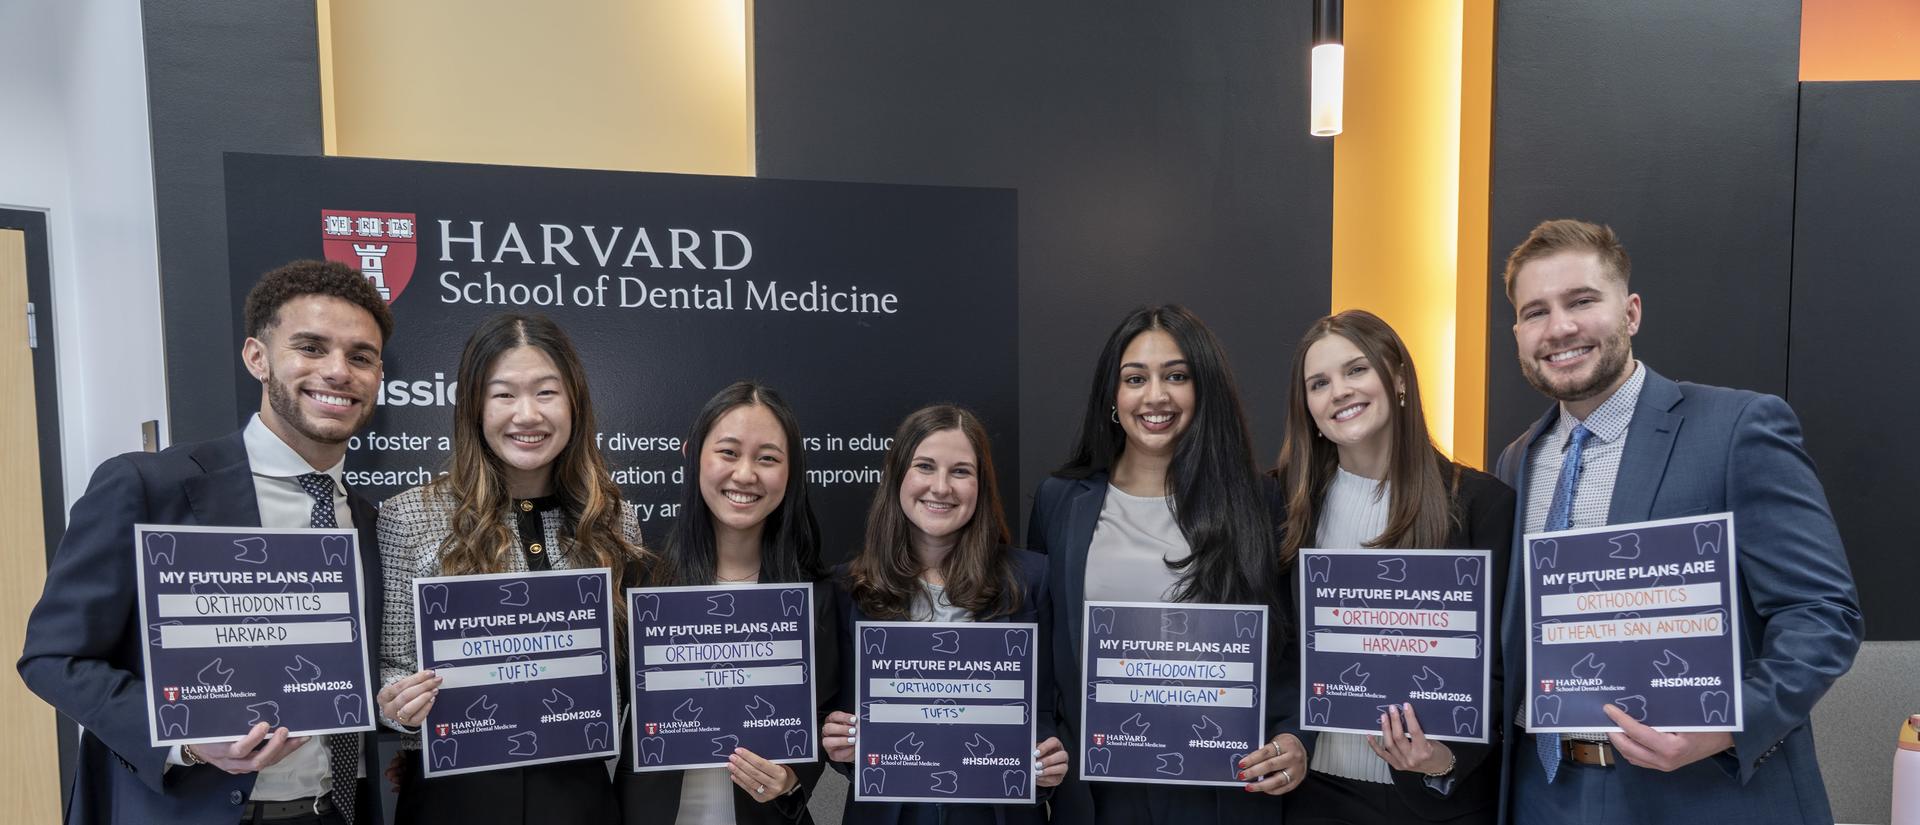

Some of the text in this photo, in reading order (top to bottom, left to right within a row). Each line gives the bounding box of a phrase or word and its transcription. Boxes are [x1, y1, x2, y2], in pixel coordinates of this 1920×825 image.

[332, 219, 345, 228] VE
[363, 221, 375, 229] RI
[437, 219, 753, 271] HARVARD
[439, 271, 898, 314] School of Dental Medicine
[348, 436, 361, 450] o
[367, 432, 432, 450] foster
[609, 433, 680, 451] diverse
[827, 434, 843, 450] in
[343, 467, 432, 485] esearch
[160, 571, 343, 583] MY FUTURE PLANS ARE
[1543, 561, 1715, 586] MY FUTURE PLANS ARE
[1316, 588, 1472, 602] MY FUTURE PLANS ARE
[1577, 588, 1687, 611] ORTHODONTICS
[196, 595, 321, 615] ORTHODONTICS
[434, 609, 596, 631] MY FUTURE PLANS ARE
[1343, 610, 1449, 627] ORTHODONTICS
[216, 626, 287, 644] HARVARD
[646, 622, 798, 637] MY FUTURE PLANS ARE
[1547, 617, 1719, 642] UT HEALTH SAN ANTONIO
[463, 634, 574, 656] ORTHODONTICS
[1100, 640, 1250, 653] MY FUTURE PLANS ARE
[1363, 638, 1428, 654] HARVARD
[666, 642, 774, 662] ORTHODONTICS
[497, 663, 538, 680] TUFTS
[872, 660, 1021, 671] MY FUTURE PLANS ARE
[1125, 663, 1226, 678] ORTHODONTICS
[705, 669, 745, 686] TUFTS
[1556, 678, 1602, 686] HARVARD
[1650, 677, 1721, 687] #HSDM2026
[181, 685, 232, 694] HARVARD
[283, 681, 353, 693] #HSDM2026
[896, 682, 992, 693] ORTHODONTICS
[1326, 684, 1366, 692] HARVARD
[182, 692, 202, 700] School
[1130, 689, 1218, 703] U-MICHIGAN
[1409, 691, 1472, 702] #HSDM2026
[541, 710, 601, 723] #HSDM2026
[921, 707, 958, 719] TUFTS
[452, 719, 495, 729] HARVARD
[660, 721, 700, 729] HARVARD
[743, 718, 801, 728] #HSDM2026
[1107, 734, 1146, 742] HARVARD
[1189, 740, 1248, 749] #HSDM2026
[962, 757, 1020, 766] #HSDM2026
